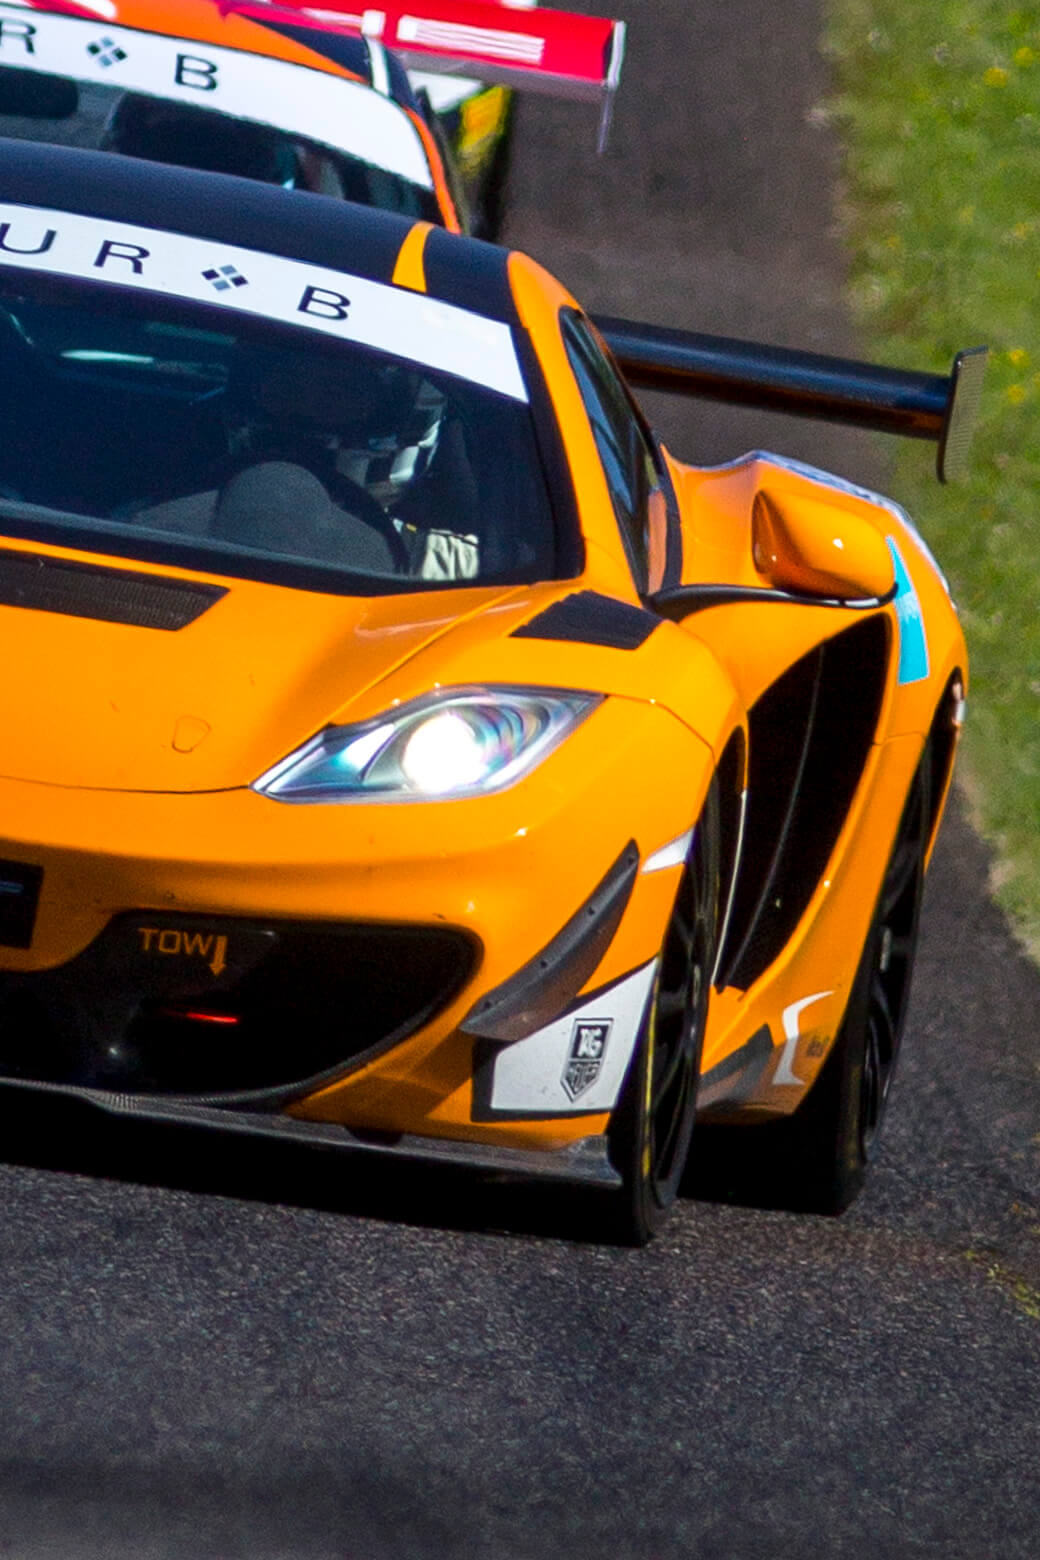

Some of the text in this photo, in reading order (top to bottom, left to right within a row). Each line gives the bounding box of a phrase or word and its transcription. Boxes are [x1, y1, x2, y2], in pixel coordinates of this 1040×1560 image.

[173, 52, 219, 92] B
[296, 284, 352, 321] B
[137, 926, 213, 957] TOW
